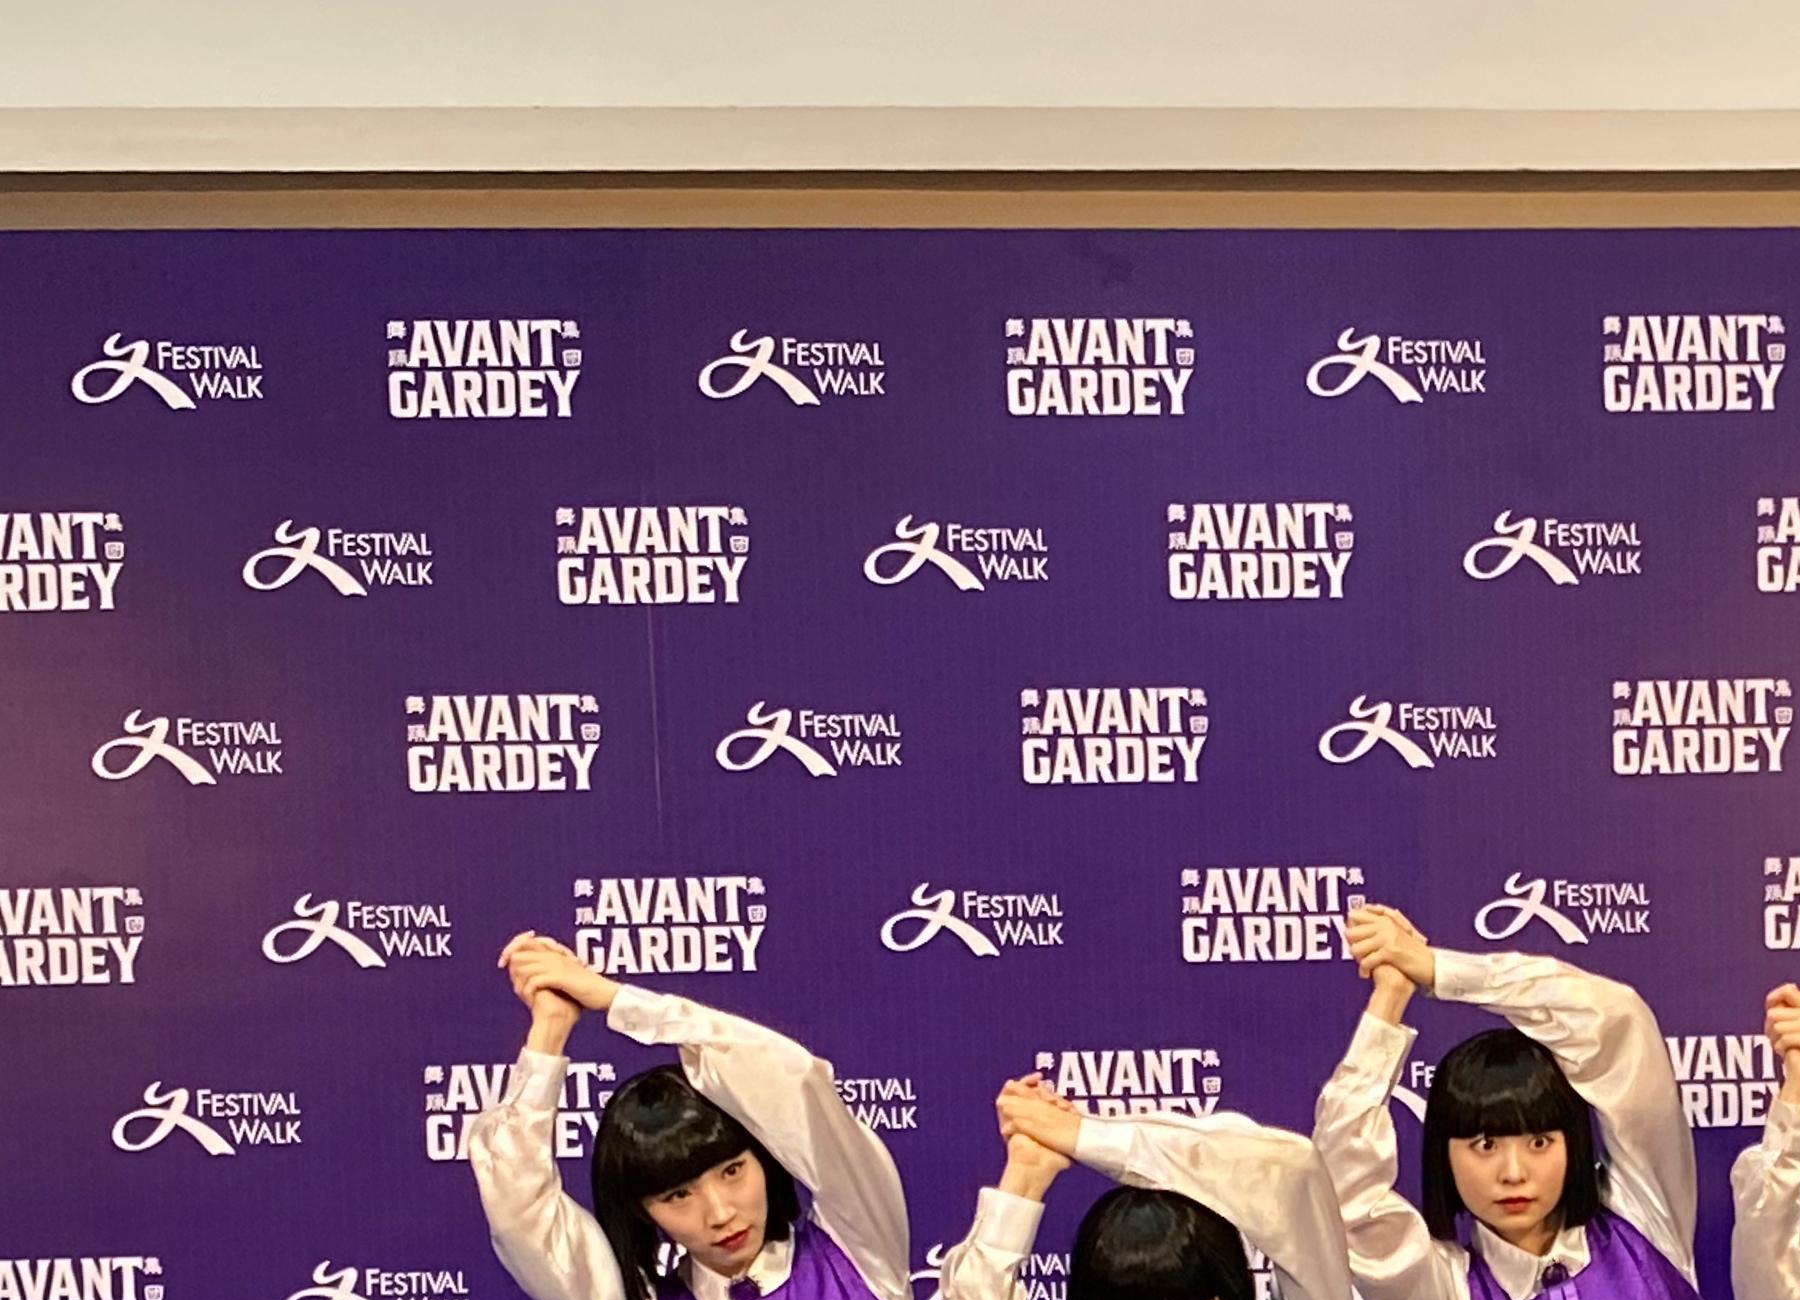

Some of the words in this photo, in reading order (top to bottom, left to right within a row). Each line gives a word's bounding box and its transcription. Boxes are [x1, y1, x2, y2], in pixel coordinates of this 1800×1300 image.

[409, 319, 562, 368] AVANT
[783, 338, 884, 366] FESTIVAL
[1027, 318, 1176, 366] AVANT
[1388, 336, 1486, 364] FESTIVAL
[1623, 314, 1768, 362] AVANT
[158, 341, 261, 370] FESTIVAL
[188, 372, 262, 400] WALK
[388, 369, 579, 419] GARDEY
[813, 368, 884, 395] WALK
[1006, 367, 1192, 417] GARDEY
[1416, 366, 1486, 393] WALK
[1603, 363, 1783, 412] GARDEY
[578, 505, 729, 555] AVANT
[948, 524, 1047, 552] FESTIVAL
[1188, 501, 1336, 550] AVANT
[1544, 519, 1641, 547] FESTIVAL
[329, 528, 431, 557] FESTIVAL
[359, 559, 432, 586] WALK
[977, 554, 1048, 581] WALK
[1168, 551, 1352, 600] GARDEY
[1572, 548, 1641, 575] WALK
[557, 555, 746, 606] GARDEY
[1042, 686, 1190, 735] AVANT
[1399, 703, 1496, 731] FESTIVAL
[1631, 678, 1776, 727] AVANT
[178, 717, 281, 746] FESTIVAL
[428, 693, 580, 743] AVANT
[800, 709, 900, 738] FESTIVAL
[829, 739, 900, 766] WALK
[1427, 732, 1496, 758] WALK
[1612, 726, 1791, 776] GARDEY
[208, 747, 282, 775] WALK
[408, 742, 597, 793] GARDEY
[1022, 735, 1206, 785] GARDEY
[596, 875, 747, 925] AVANT
[1201, 865, 1348, 915] AVANT
[1554, 879, 1650, 907] FESTIVAL
[0, 887, 124, 936] VANT
[348, 901, 450, 930] FESTIVAL
[964, 891, 1063, 919] FESTIVAL
[993, 920, 1063, 947] WALK
[1582, 908, 1650, 934] WALK
[378, 931, 451, 958] WALK
[577, 913, 764, 973] GARDEY
[1056, 1047, 1203, 1097] AVANT
[1666, 1034, 1775, 1082] VANT
[197, 1089, 300, 1117] FESTIVAL
[227, 1118, 301, 1145] WALK
[367, 1268, 468, 1296] FESTIVAL
